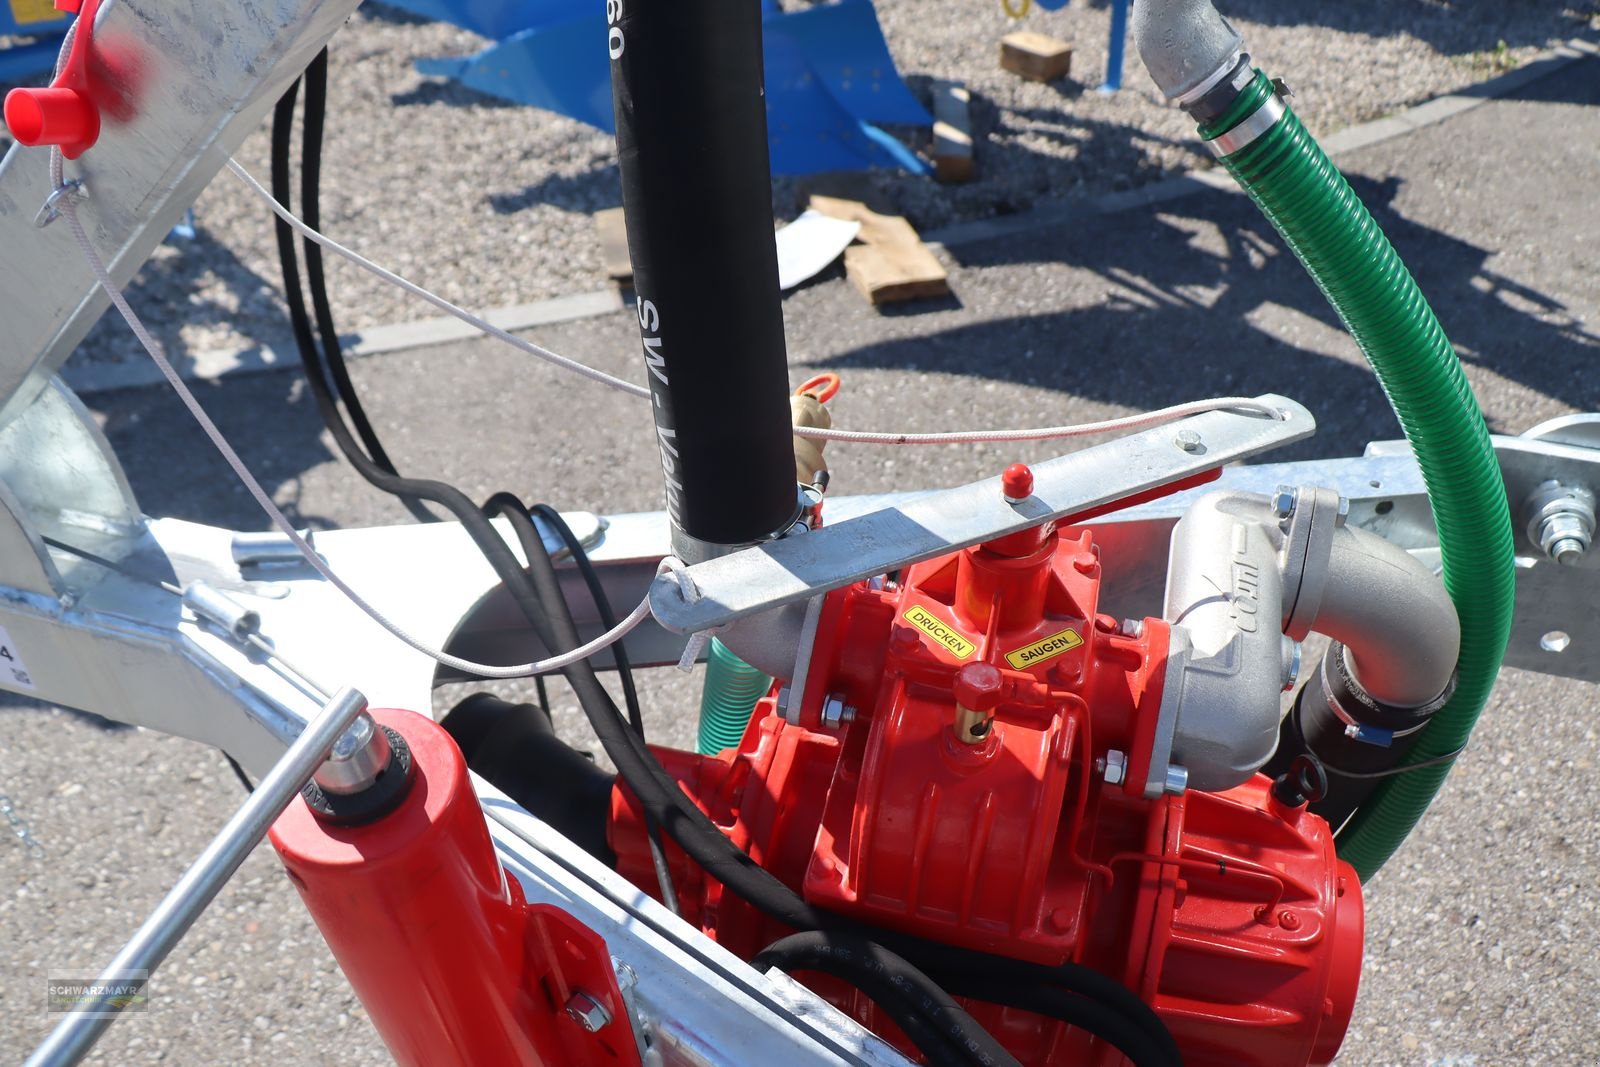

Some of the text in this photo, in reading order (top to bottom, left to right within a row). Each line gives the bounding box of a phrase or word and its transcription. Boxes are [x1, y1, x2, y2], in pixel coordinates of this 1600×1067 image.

[637, 295, 669, 386] SW
[656, 425, 684, 527] Vaku
[912, 612, 966, 652] DRÜCKEN
[0, 645, 14, 662] 4
[1020, 636, 1070, 662] SAUGEN
